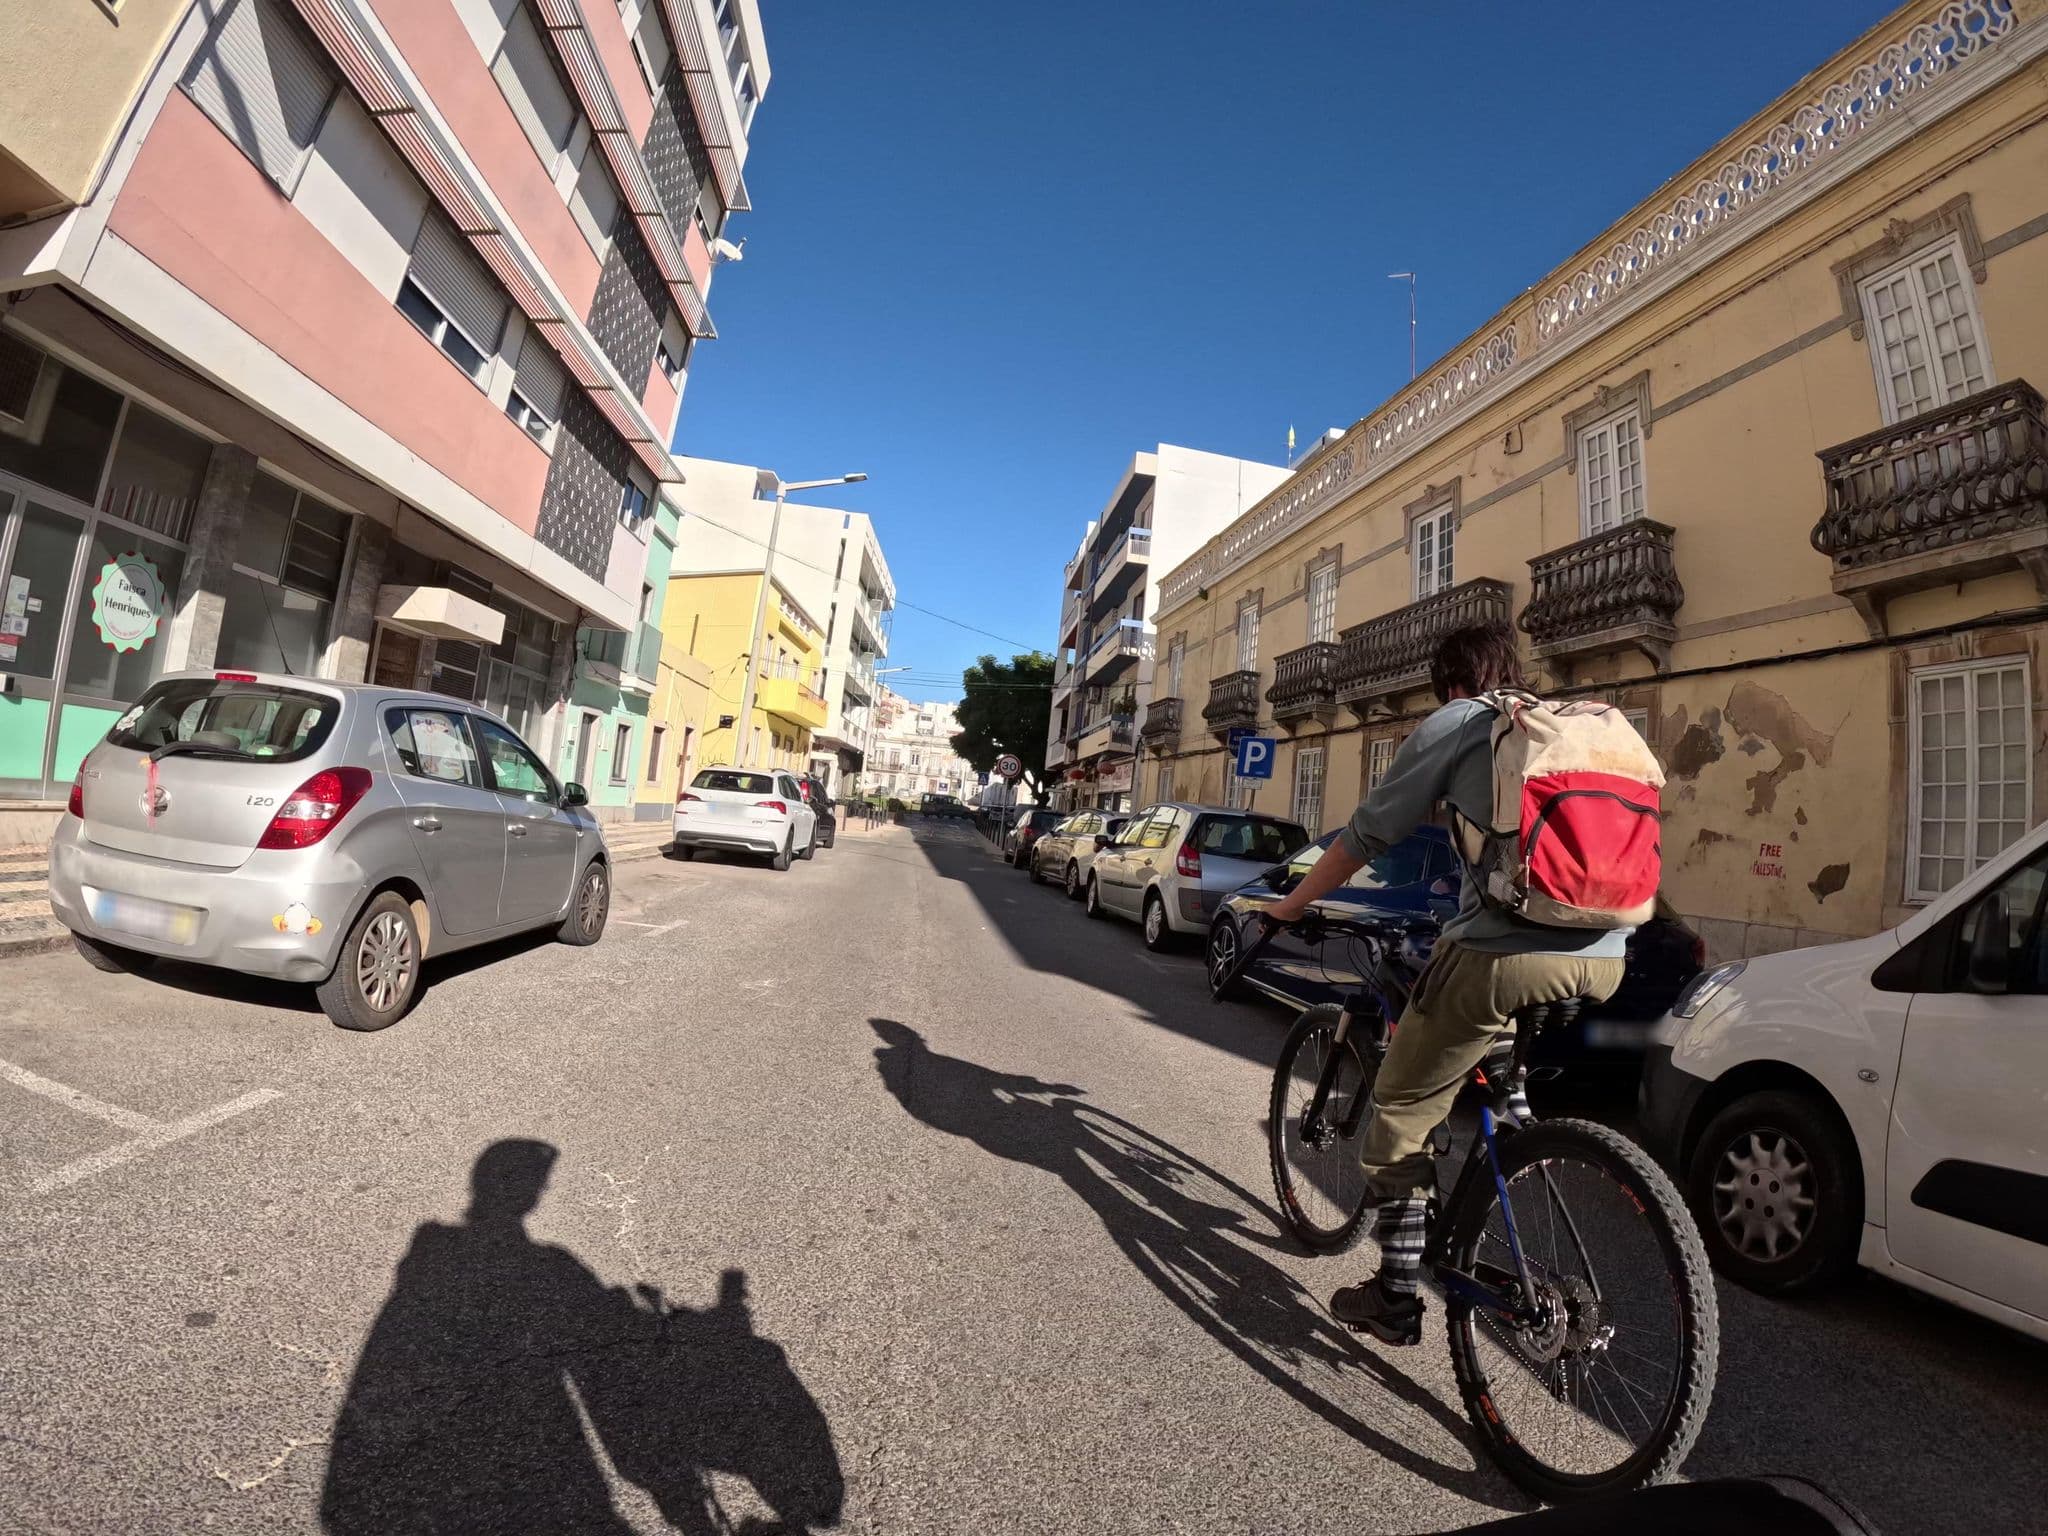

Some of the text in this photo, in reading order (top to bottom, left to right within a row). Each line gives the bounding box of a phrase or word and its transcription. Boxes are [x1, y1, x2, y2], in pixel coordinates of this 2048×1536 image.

[104, 596, 151, 619] Henriques
[1243, 741, 1267, 774] P
[1001, 761, 1017, 772] 30
[246, 794, 274, 806] i20
[1759, 843, 1782, 858] FREE
